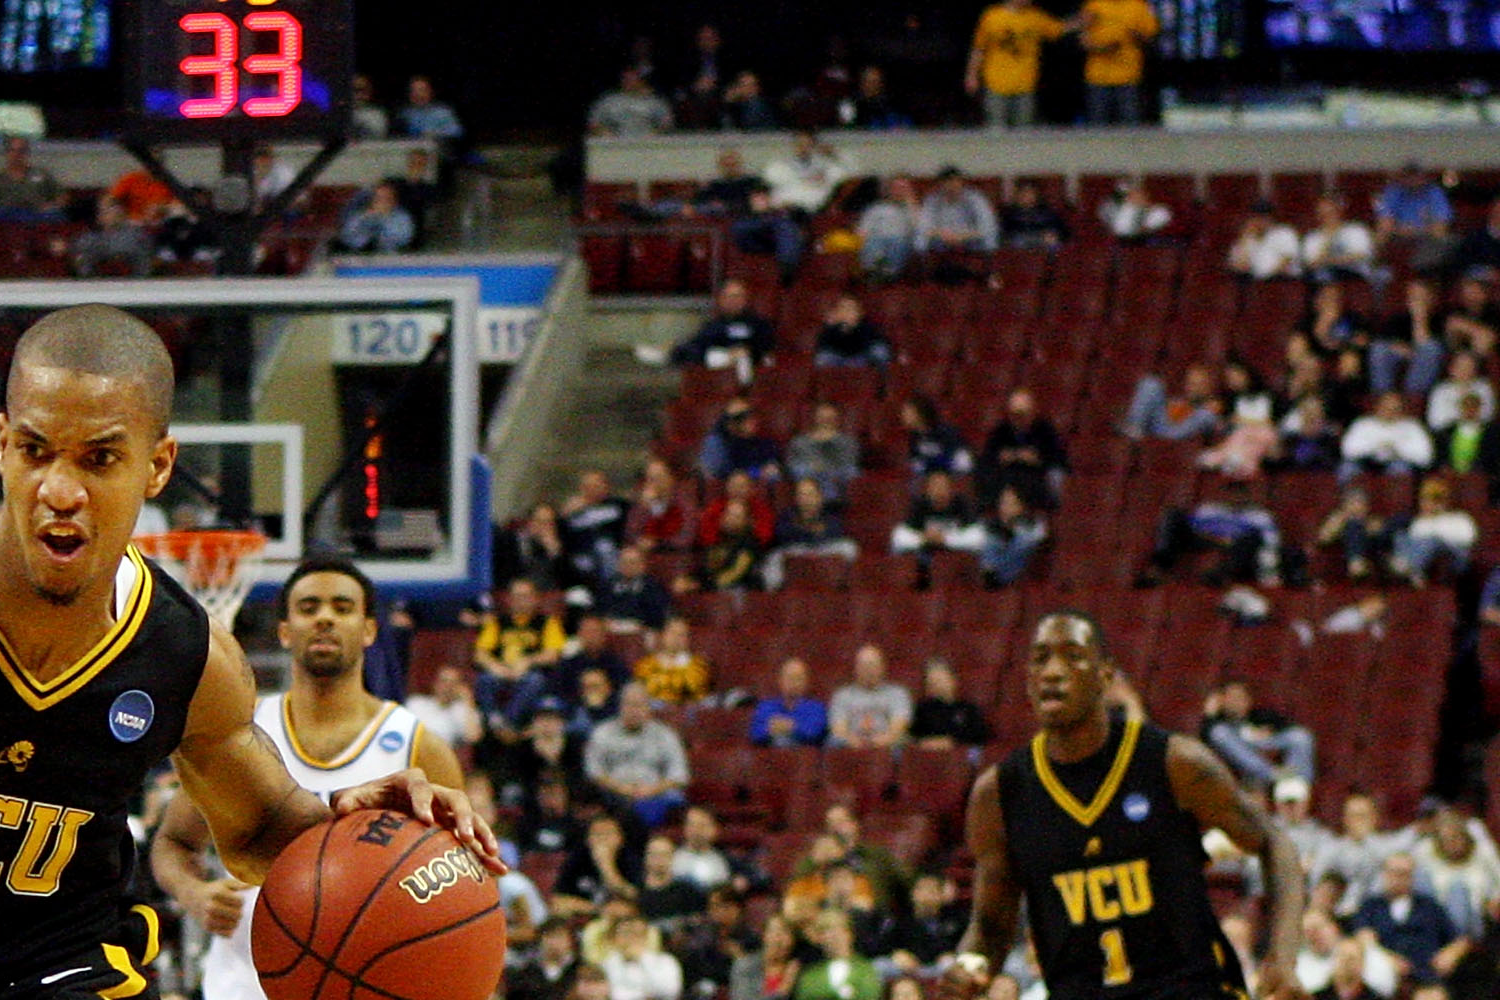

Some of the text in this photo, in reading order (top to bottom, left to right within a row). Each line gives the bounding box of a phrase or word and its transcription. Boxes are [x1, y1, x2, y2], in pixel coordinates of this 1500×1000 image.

[179, 11, 303, 119] 33
[349, 319, 420, 354] 120
[398, 846, 486, 904] lson
[1052, 859, 1155, 925] VCU
[1100, 929, 1133, 987] 1
